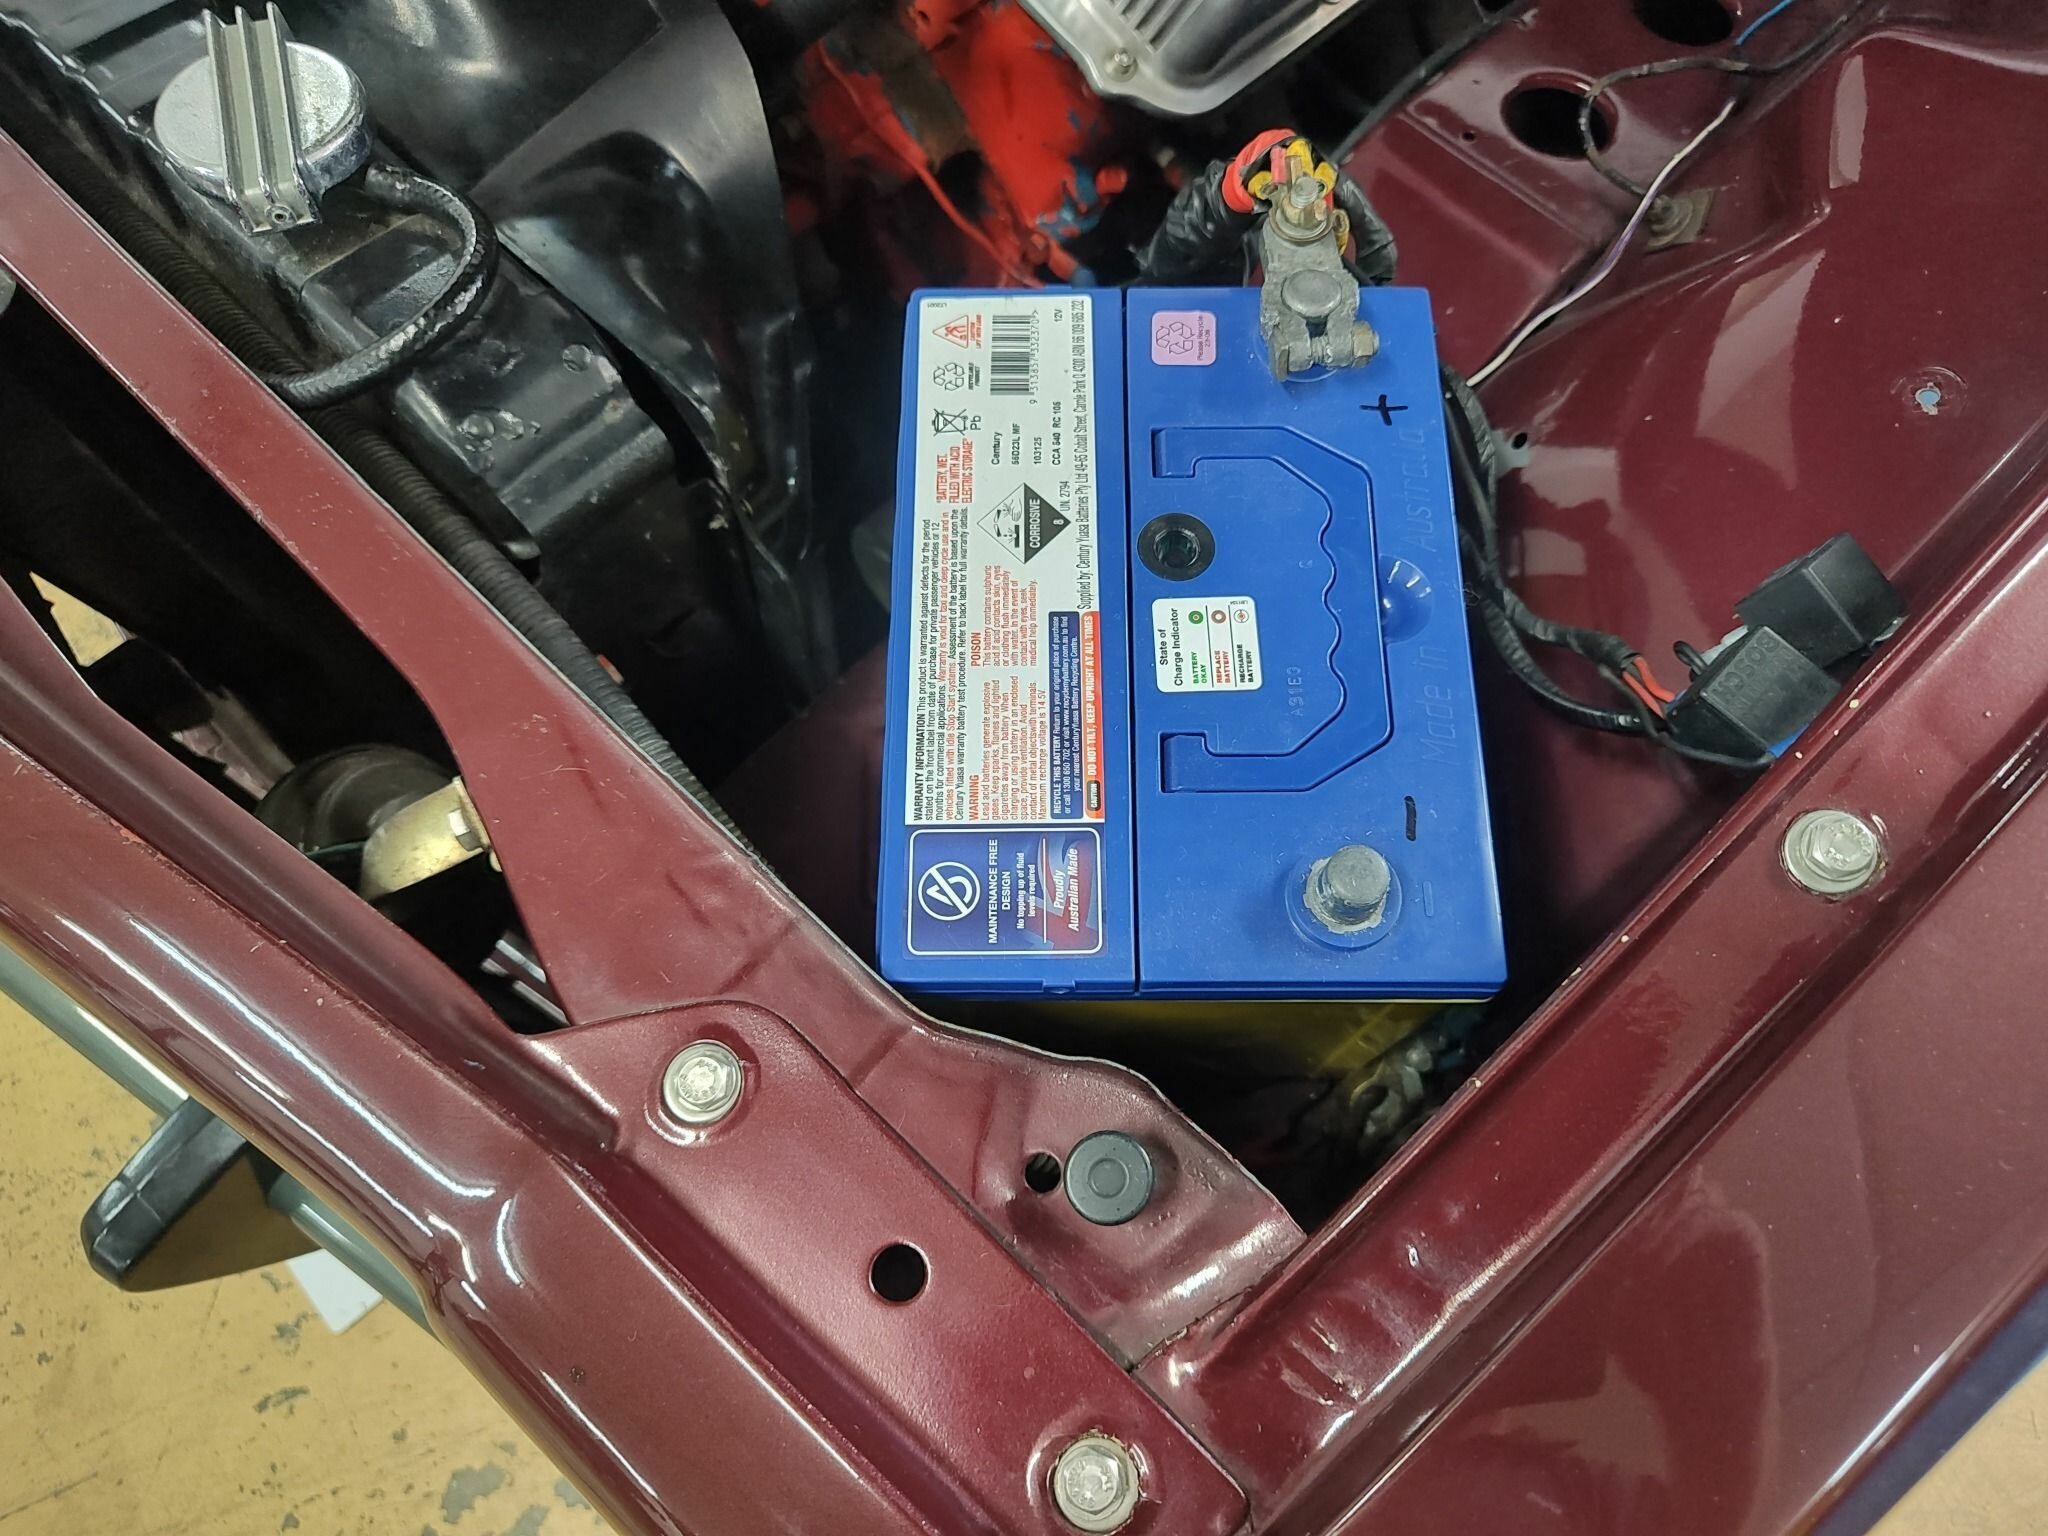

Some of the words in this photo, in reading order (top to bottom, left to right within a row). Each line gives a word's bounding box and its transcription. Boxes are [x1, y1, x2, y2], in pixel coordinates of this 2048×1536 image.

[1054, 308, 1062, 322] 12V
[1071, 324, 1084, 334] 009
[1072, 358, 1085, 371] 4300
[1072, 379, 1085, 392] Park
[1052, 401, 1060, 413] 105
[1072, 394, 1086, 412] Carole
[970, 415, 981, 430] Pb
[1011, 423, 1020, 433] MF
[1052, 416, 1060, 427] RC
[991, 431, 1002, 464] Century
[1033, 436, 1041, 464] 103125
[1052, 432, 1060, 445] 540
[1073, 434, 1087, 452] Cobalt
[949, 446, 960, 461] ACID
[1052, 447, 1060, 465] CCA
[1073, 454, 1087, 471] 49-65
[949, 463, 959, 479] WITH
[1074, 473, 1088, 482] Ltd
[948, 481, 959, 503] FILLED
[961, 472, 972, 503] ELECTRIC
[1059, 480, 1070, 497] 2794
[1074, 484, 1091, 494] Pty
[1074, 496, 1088, 522] Batteries
[922, 519, 931, 540] period
[951, 520, 960, 538] upon
[1029, 498, 1040, 547] CORROSIVE
[1075, 524, 1089, 542] Yuasa
[921, 541, 930, 552] the
[931, 541, 939, 569] vehicles
[949, 539, 958, 560] based
[959, 530, 969, 560] warranty
[1075, 544, 1093, 568] Century
[920, 565, 929, 590] defects
[959, 561, 967, 571] full
[931, 570, 940, 607] passenger
[939, 584, 948, 598] and
[949, 568, 959, 593] battery
[983, 565, 993, 595] sulphuric
[948, 595, 957, 606] the
[958, 584, 967, 600] label
[1076, 582, 1094, 608] Supplied
[919, 592, 929, 618] against
[958, 602, 966, 619] back
[929, 608, 939, 632] private
[1052, 616, 1060, 643] purchase
[1084, 615, 1093, 638] TIMES
[1171, 608, 1180, 648] Indicator
[918, 619, 928, 656] warranted
[938, 625, 947, 640] void
[947, 616, 956, 659] Assessment
[957, 629, 966, 647] Refer
[983, 626, 992, 650] battery
[1001, 630, 1010, 657] clothing
[1158, 629, 1166, 638] of
[971, 632, 981, 666] POISON
[1052, 651, 1061, 667] place
[1084, 641, 1094, 654] ALL
[1159, 641, 1168, 665] State
[928, 646, 938, 679] purchase
[937, 649, 948, 682] Warranty
[1085, 655, 1094, 665] AT
[1173, 652, 1183, 686] Charge
[1191, 652, 1199, 684] BATTERY
[1237, 644, 1245, 683] RECHARGE
[917, 666, 927, 694] product
[1052, 668, 1061, 690] original
[1085, 668, 1095, 701] UPRIGHT
[927, 690, 936, 707] date
[956, 688, 965, 702] test
[982, 681, 992, 714] explosive
[992, 679, 1001, 703] lighted
[1071, 687, 1080, 709] Battery
[917, 696, 925, 710] This
[946, 694, 955, 712] Start
[1085, 702, 1095, 723] KEEP
[926, 709, 935, 727] from
[946, 714, 956, 731] Stop
[956, 704, 966, 730] battery
[915, 713, 925, 770] INFORMATION
[926, 729, 935, 747] label
[945, 732, 954, 746] Idle
[982, 716, 991, 748] generate
[1010, 728, 1019, 754] battery
[1038, 720, 1047, 746] voltage
[1086, 724, 1097, 744] TILT,
[925, 749, 934, 767] front
[935, 731, 944, 776] commercial
[945, 748, 954, 764] with
[955, 731, 966, 764] warranty
[1086, 745, 1096, 762] NOT
[981, 750, 990, 782] batteries
[991, 747, 1000, 773] sparks,
[1010, 755, 1019, 775] using
[1038, 748, 1047, 781] recharge
[1087, 763, 1096, 774] DO
[925, 769, 934, 782] the
[945, 766, 954, 786] fitted
[955, 766, 964, 788] Yuasa
[991, 775, 1000, 794] Keep
[913, 772, 923, 820] WARRANTY
[944, 788, 953, 819] vehicles
[968, 774, 979, 820] WARNING
[981, 784, 990, 800] acid
[1000, 783, 1009, 819] cigarettes
[1010, 787, 1019, 819] charging
[1053, 782, 1061, 813] RECYCLE
[1089, 783, 1098, 808] CAUTION
[924, 796, 933, 820] stated
[934, 791, 943, 820] months
[954, 790, 965, 819] Century
[981, 802, 989, 820] Lead
[989, 840, 998, 864] FREE
[1068, 849, 1078, 876] Made
[1002, 872, 1010, 910] DESIGN
[1018, 879, 1026, 888] up
[1028, 865, 1037, 894] required
[1054, 870, 1065, 909] Proudly
[989, 868, 998, 943] MAINTENANCE
[1017, 891, 1026, 917] topping
[1068, 878, 1079, 931] Australian
[1017, 919, 1024, 928] No
